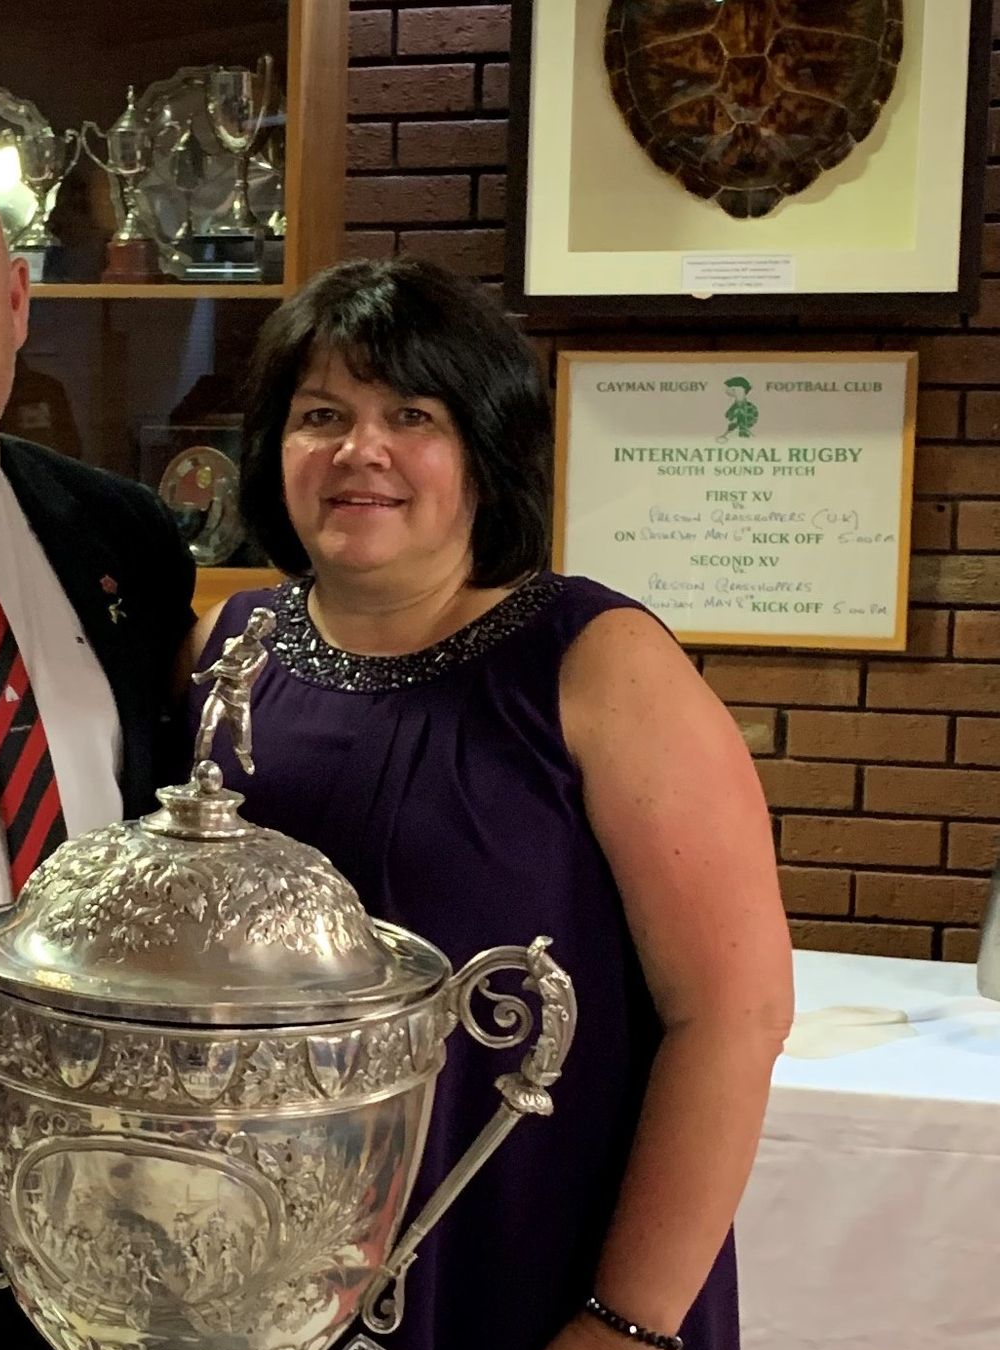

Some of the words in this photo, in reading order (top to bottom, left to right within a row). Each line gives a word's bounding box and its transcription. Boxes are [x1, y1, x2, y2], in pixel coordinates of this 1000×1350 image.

[597, 381, 655, 393] CAYMAN
[660, 381, 708, 393] RUGBY
[766, 381, 839, 392] FOOTBALL
[844, 381, 882, 392] CLUB
[614, 447, 781, 463] INTERNATIONAL
[788, 447, 863, 463] RUGBY
[657, 465, 704, 476] SOUTH
[714, 465, 764, 476] SOUND
[773, 465, 815, 476] PITCH
[705, 490, 748, 502] FIRST
[752, 490, 773, 502] XV
[614, 530, 636, 542] ON
[752, 533, 789, 545] KICK
[794, 533, 824, 545] OFF
[690, 555, 754, 567] SECOND
[759, 556, 779, 567] XV
[752, 602, 788, 614] KICK
[794, 602, 823, 614] OFF
